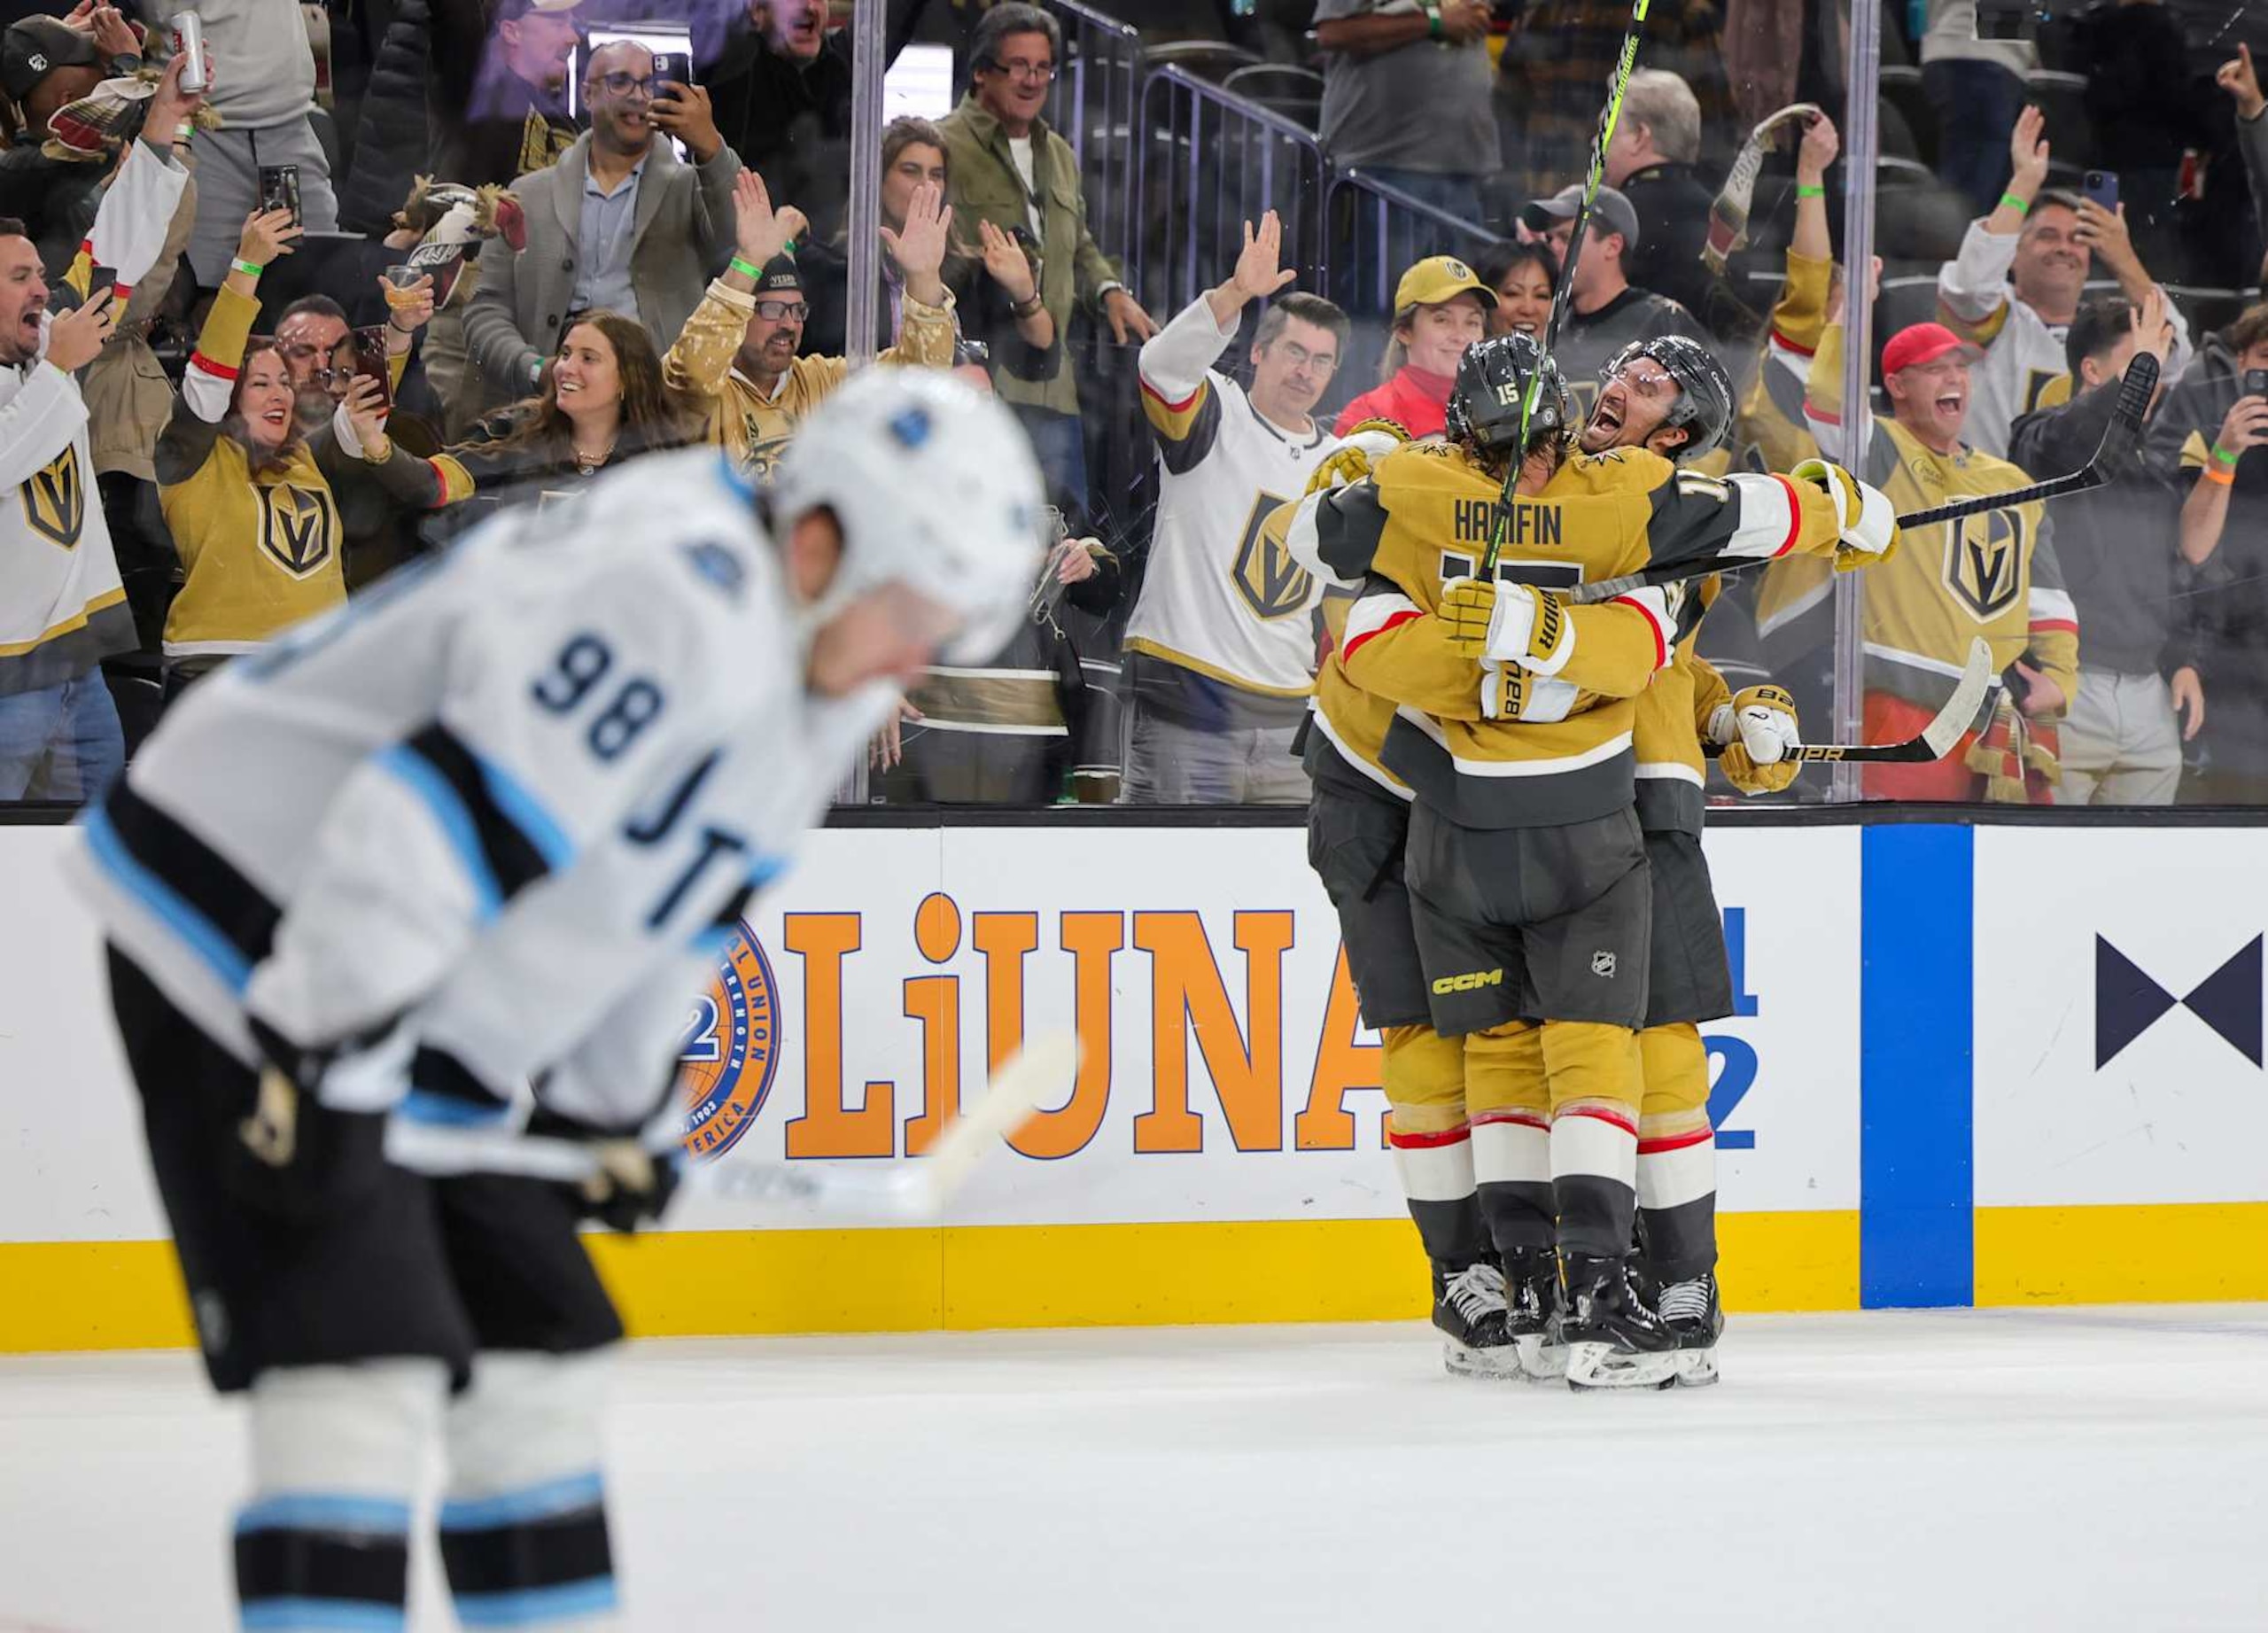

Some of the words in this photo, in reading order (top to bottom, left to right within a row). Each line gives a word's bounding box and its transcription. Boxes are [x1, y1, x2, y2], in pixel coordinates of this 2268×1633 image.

[1496, 382, 1520, 406] 15
[532, 634, 664, 762] 98
[720, 961, 746, 1069] TRENGTH
[1432, 968, 1503, 995] CCM
[747, 976, 769, 1061] UNION
[784, 891, 1394, 1160] LiUNA
[691, 1100, 717, 1125] 1903
[692, 1100, 745, 1154] ERICA
